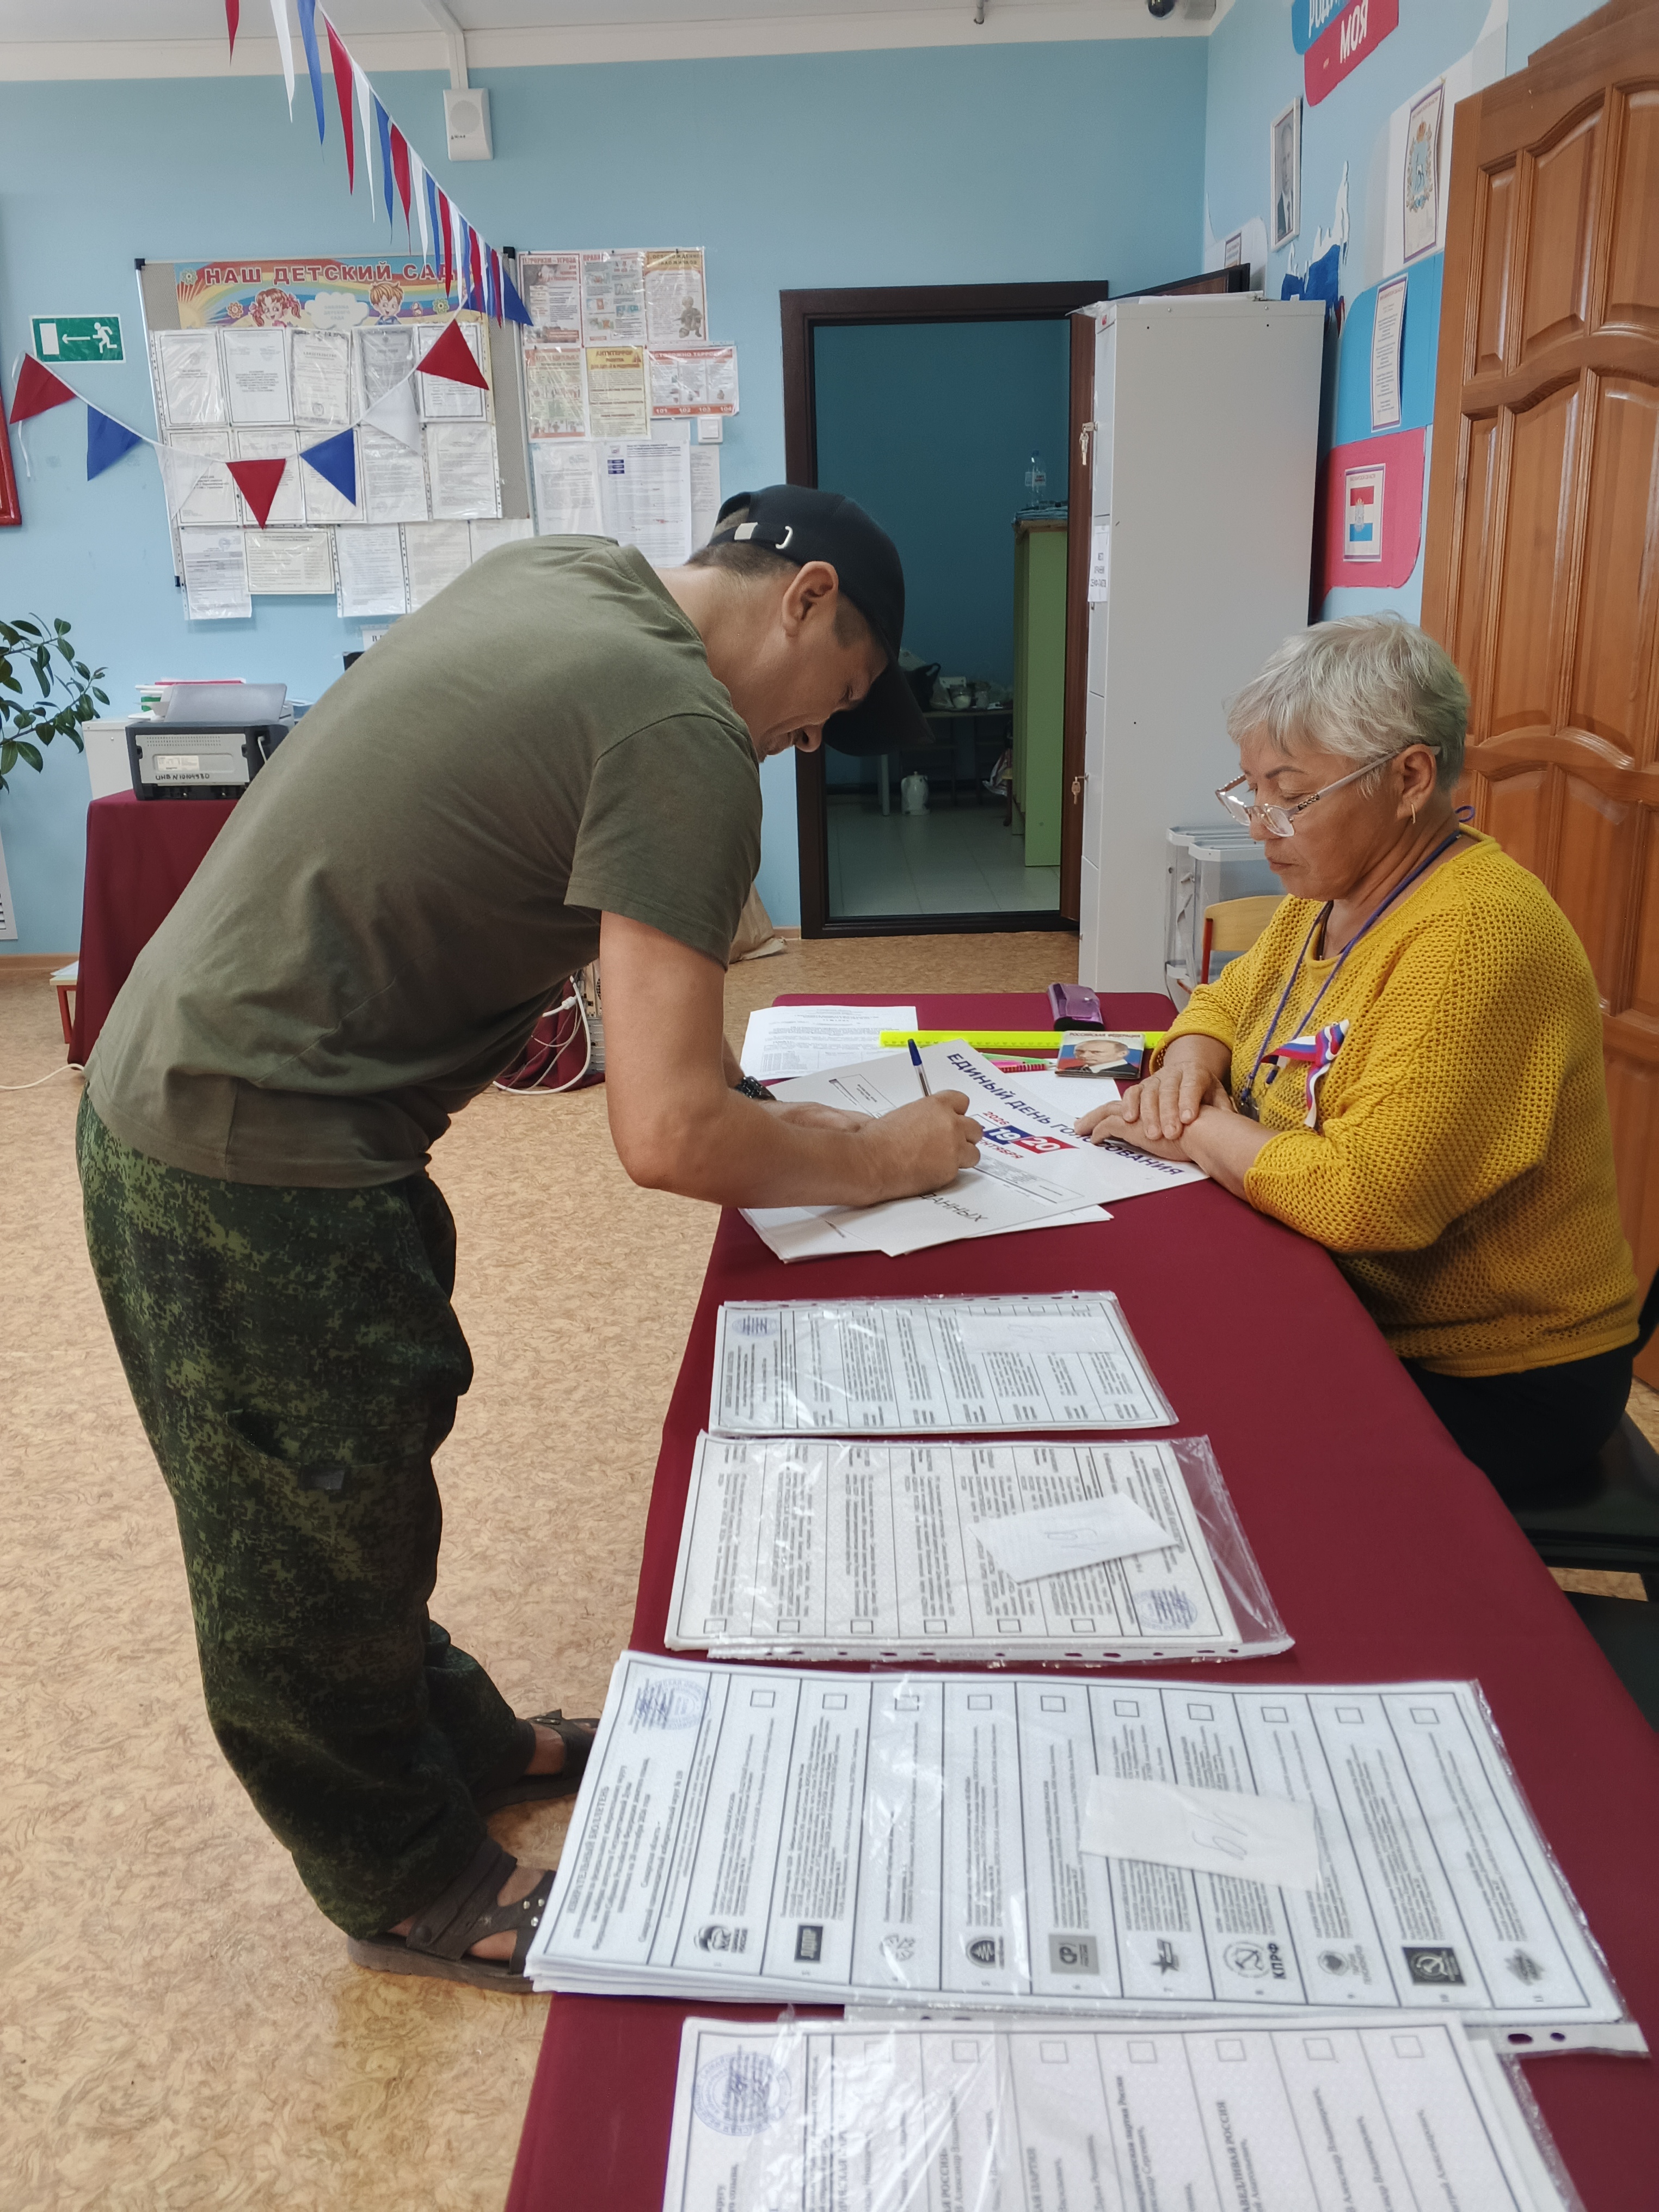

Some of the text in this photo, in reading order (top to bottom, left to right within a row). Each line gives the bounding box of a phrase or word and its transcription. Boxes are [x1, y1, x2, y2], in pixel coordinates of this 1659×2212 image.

[1340, 0, 1368, 64] МОЯ
[204, 262, 458, 285] НАШ ДЕТСКИЙ САД
[947, 1053, 1013, 1099] ЕДИНЫЙ
[1005, 1100, 1050, 1128] ДЕНЬ
[982, 1111, 1010, 1126] 2026
[979, 1138, 1024, 1159] ЕНТЯБРЯ
[989, 1128, 1055, 1152] 19 20
[1267, 1942, 1286, 1980] КПРФ
[1215, 2100, 1251, 2212] АВЕДЛИВАЯ РОССИЯ
[1146, 2176, 1159, 2212] ександр
[1331, 2154, 1353, 2203] Александр
[1377, 2186, 1393, 2212] сандр
